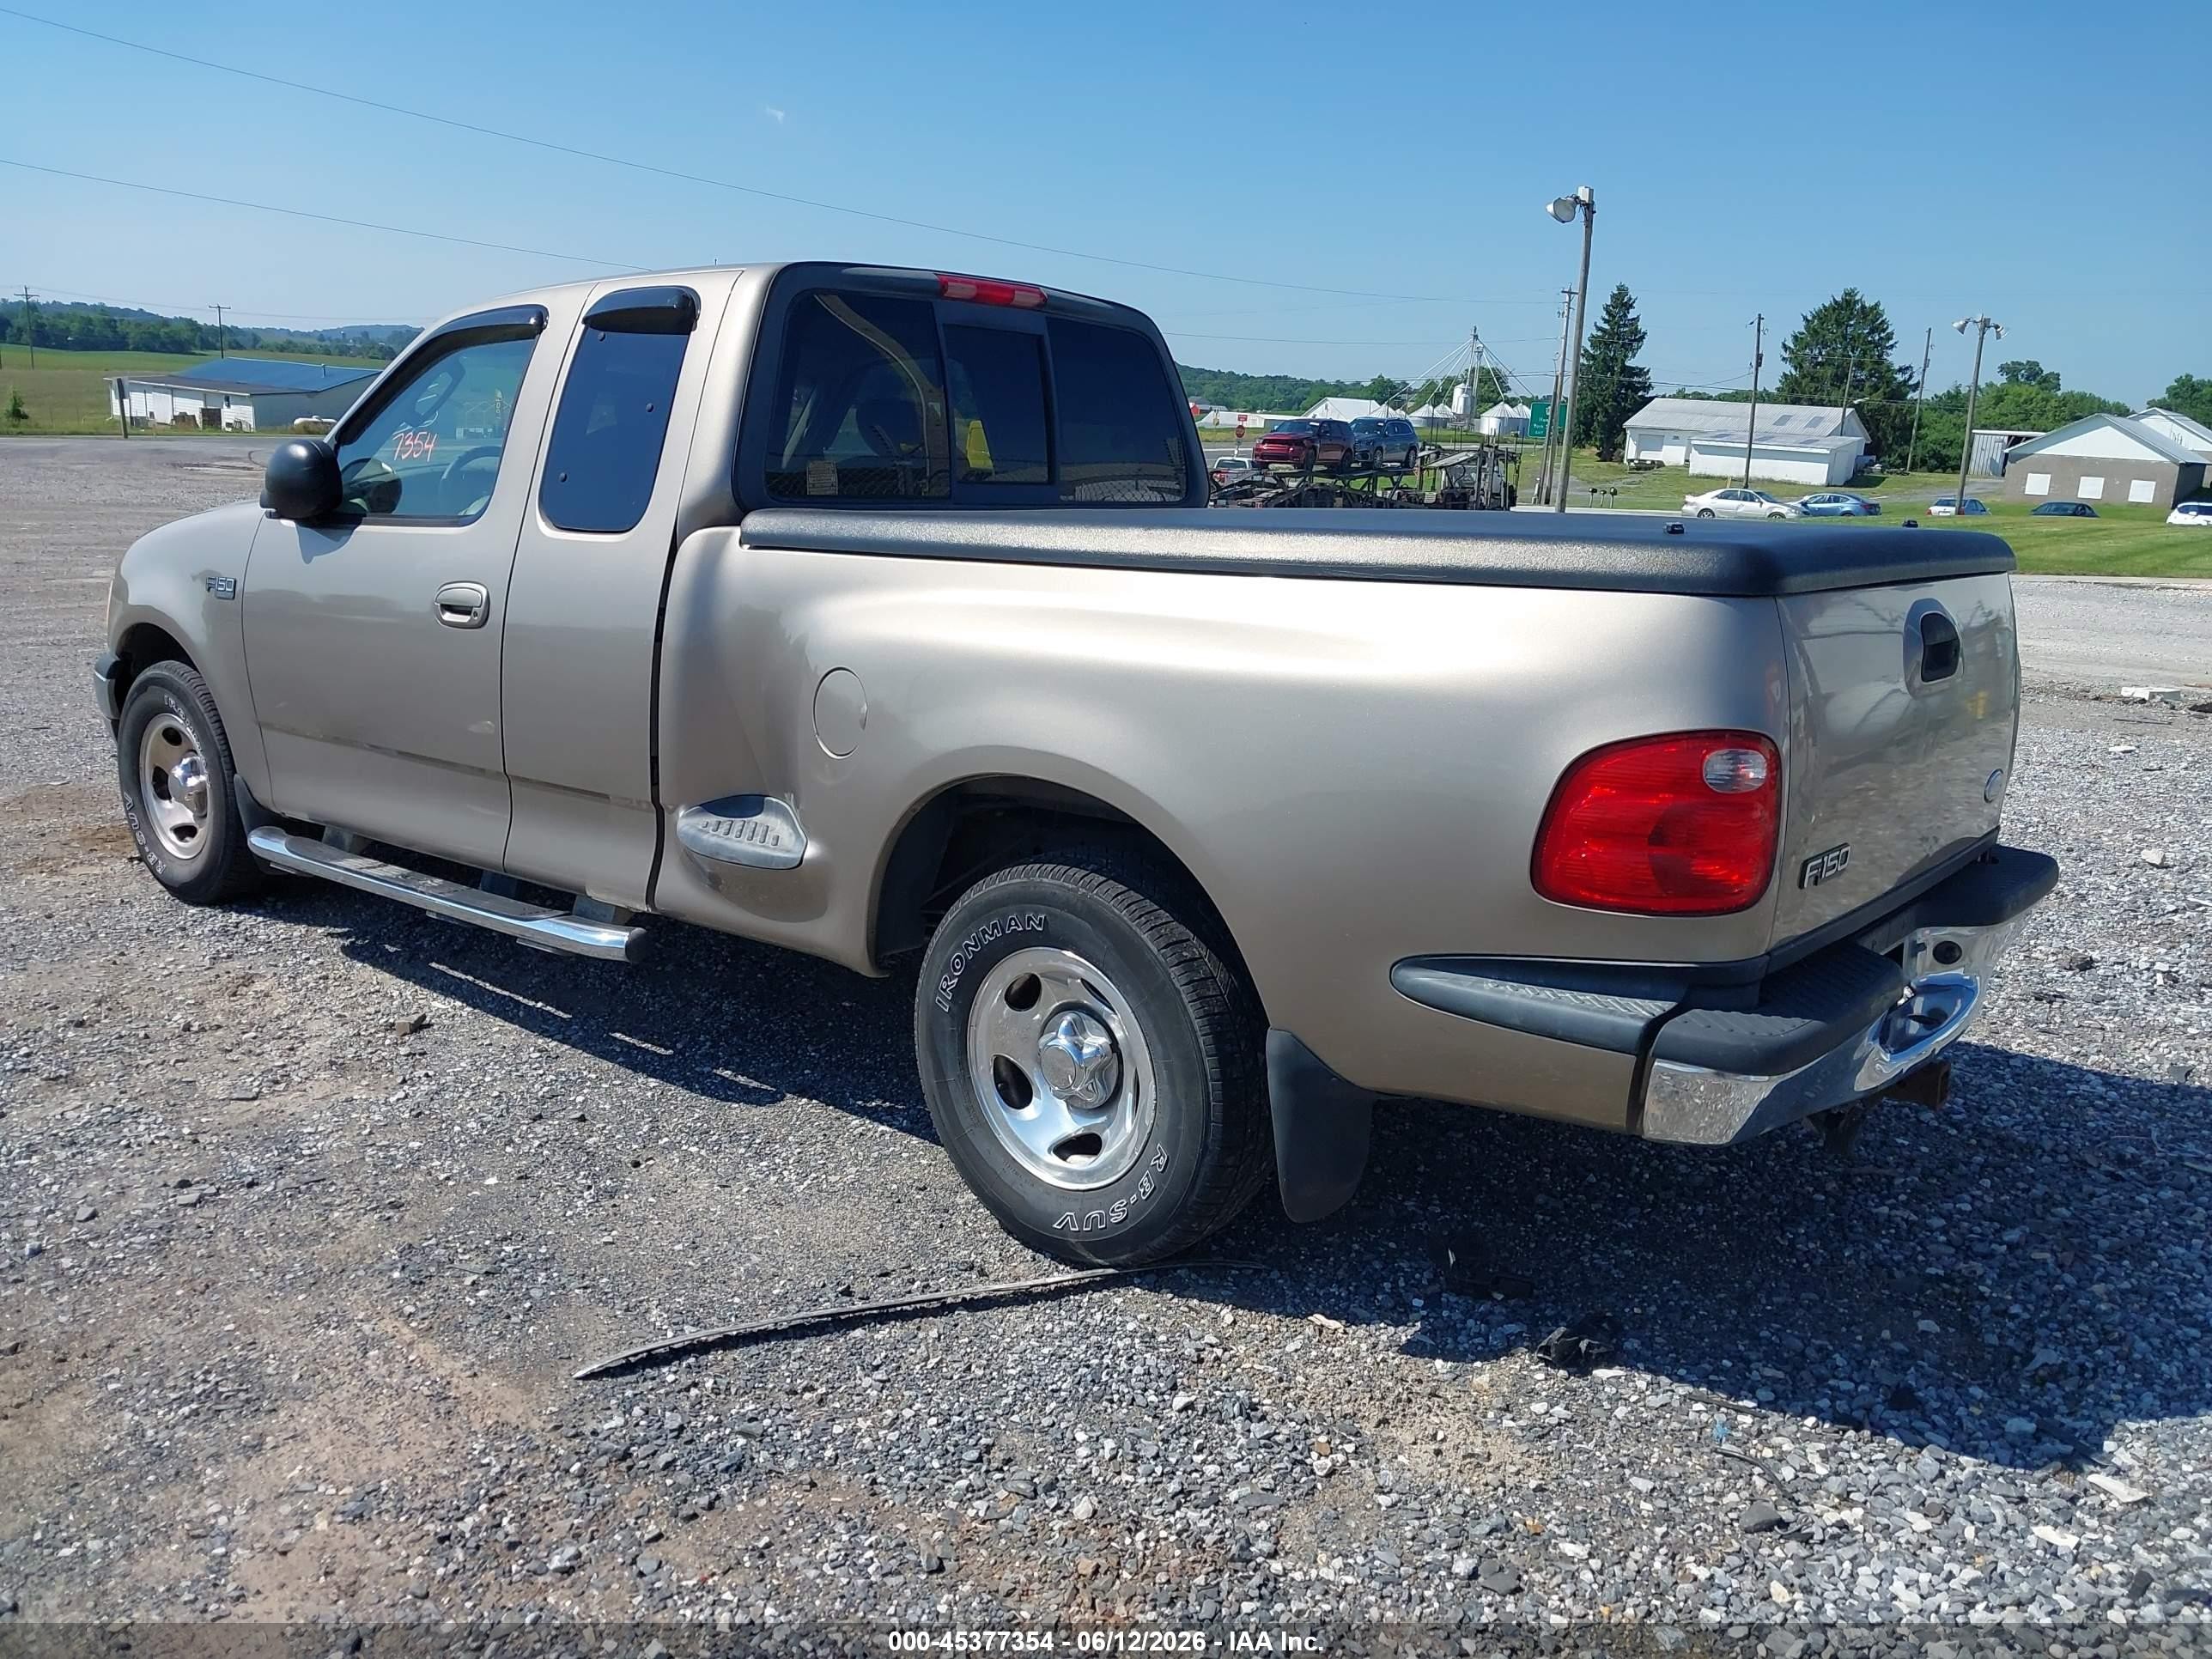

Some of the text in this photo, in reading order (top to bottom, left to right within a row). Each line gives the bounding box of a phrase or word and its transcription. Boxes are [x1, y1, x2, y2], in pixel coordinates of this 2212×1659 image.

[392, 432, 438, 462] 7354
[936, 915, 1045, 1012] IRONMAN
[1052, 1144, 1168, 1231] RB-SUV
